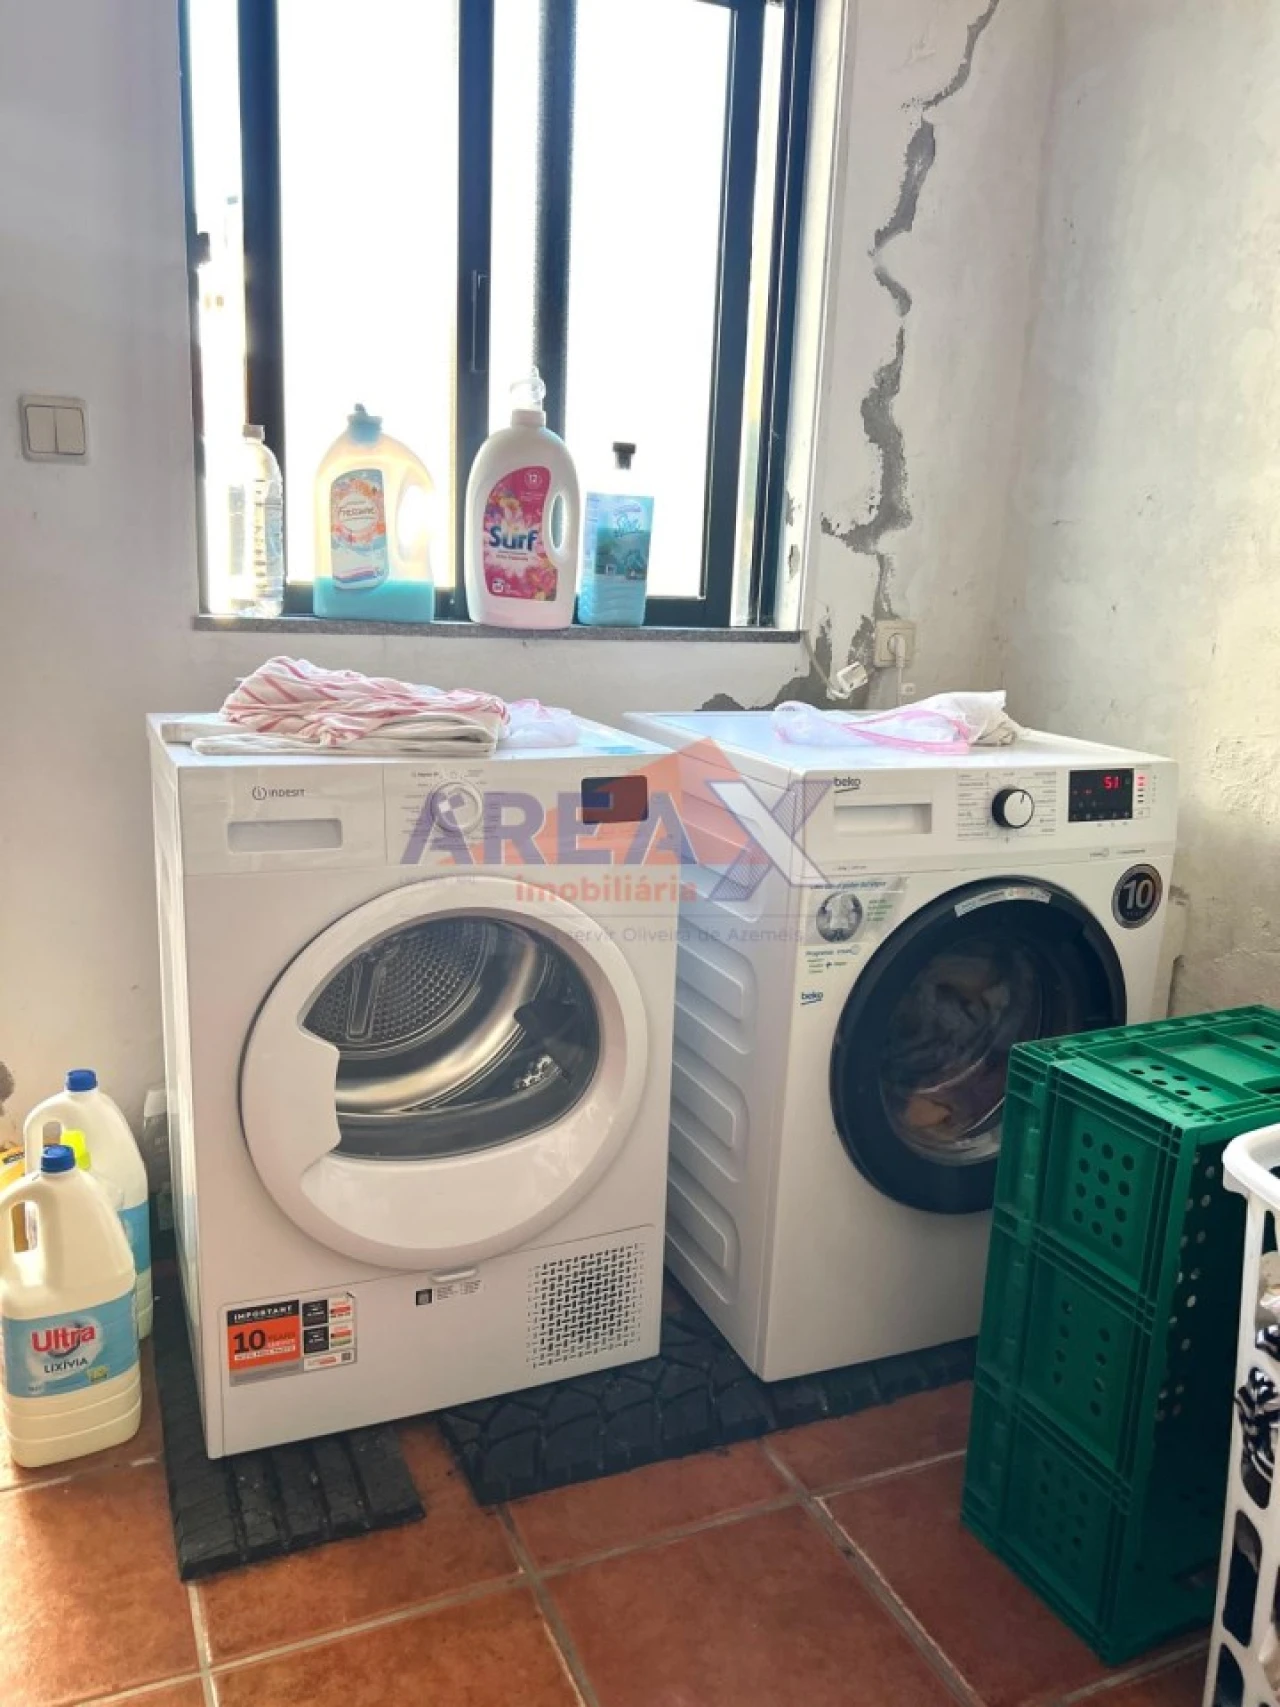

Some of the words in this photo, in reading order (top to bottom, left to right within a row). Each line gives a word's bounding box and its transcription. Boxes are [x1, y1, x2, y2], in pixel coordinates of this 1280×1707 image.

[488, 525, 540, 551] Surf
[833, 776, 861, 789] beko
[268, 788, 305, 798] INDESIT
[1123, 879, 1153, 910] 10
[801, 991, 824, 1002] beko
[234, 1305, 294, 1321] IMPORTANT
[31, 1325, 96, 1352] Ultra
[232, 1329, 266, 1354] 10
